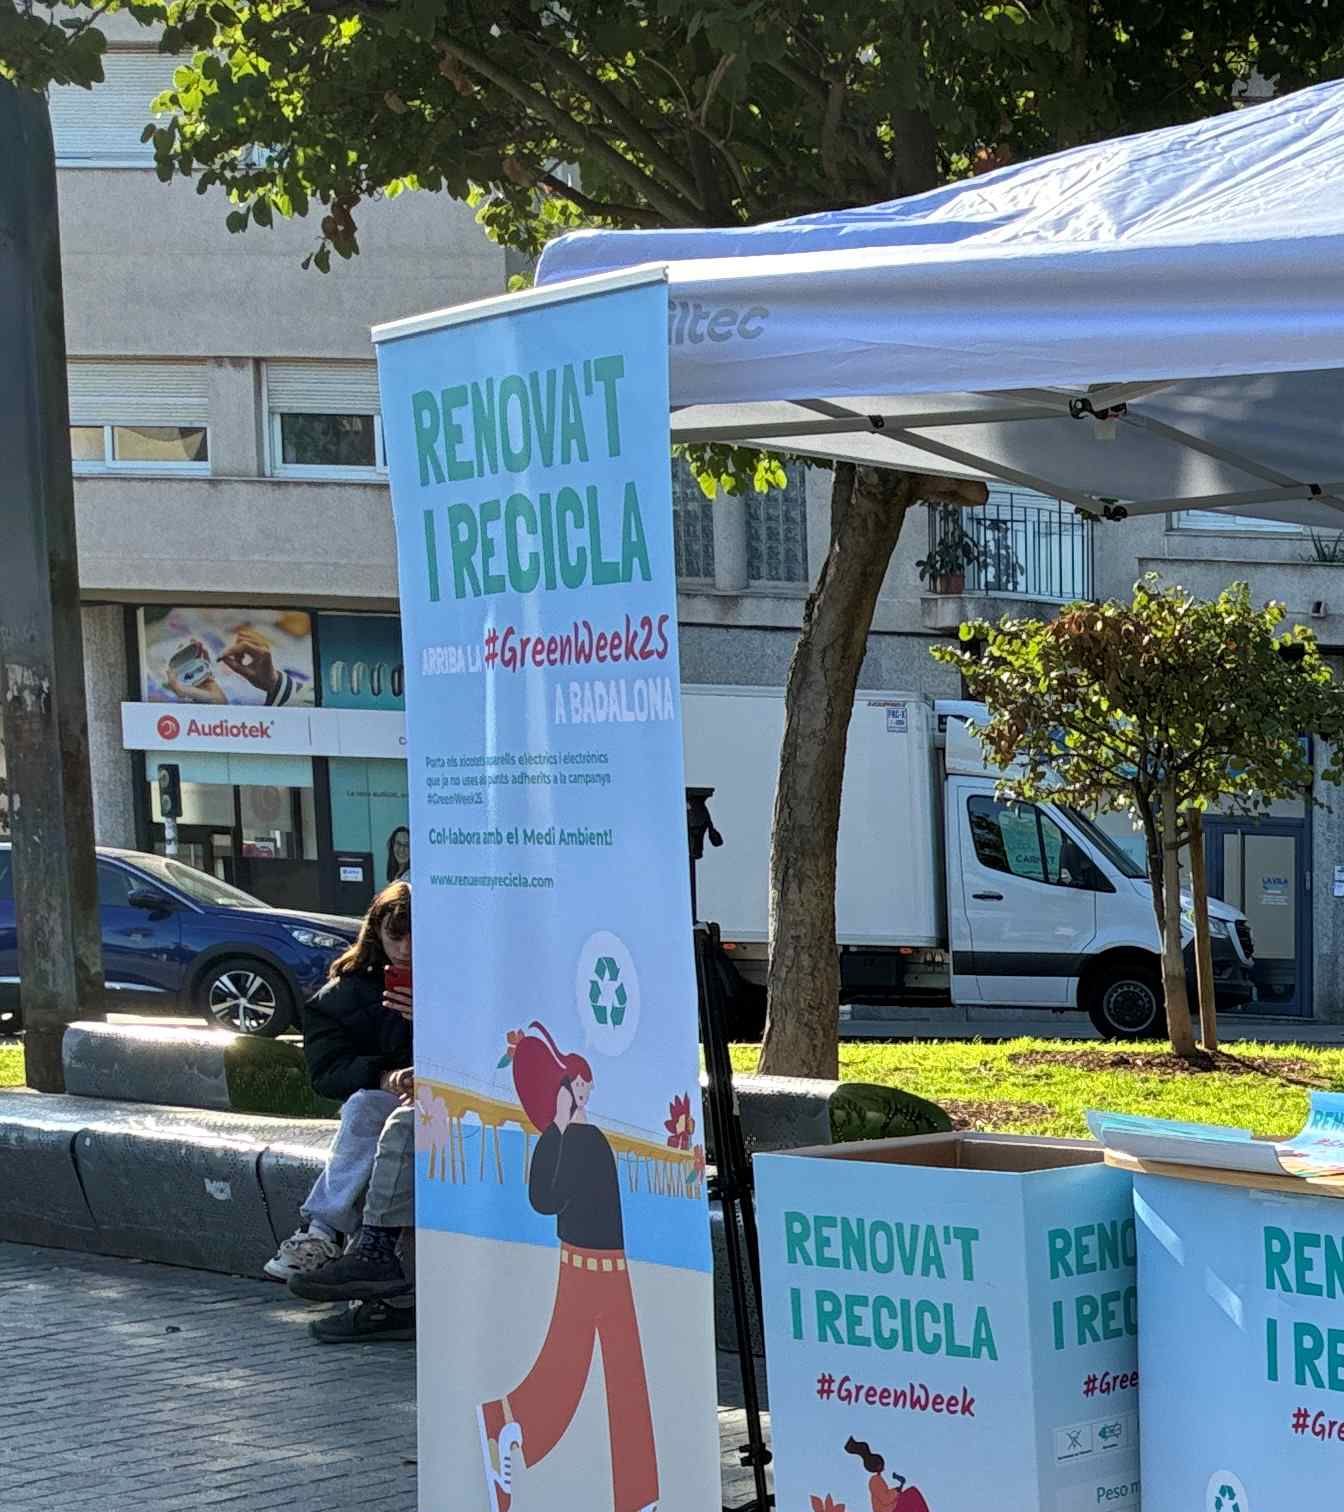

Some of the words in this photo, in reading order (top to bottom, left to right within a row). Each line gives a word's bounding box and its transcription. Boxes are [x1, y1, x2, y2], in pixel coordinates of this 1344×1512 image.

[411, 355, 624, 487] RENOVA'T
[424, 509, 440, 601] I
[448, 481, 651, 598] RECICLA
[422, 646, 464, 675] ARRIBA
[484, 613, 669, 672] #GreenWeek25
[555, 683, 566, 724] A
[570, 677, 674, 724] BADALONA
[186, 719, 271, 739] Audiotek
[483, 828, 503, 846] amb
[506, 827, 519, 845] el
[523, 827, 555, 846] Medi
[559, 828, 613, 847] Ambient!
[784, 1211, 980, 1281] RENOVA'T
[790, 1287, 802, 1340] I
[815, 1289, 998, 1361] RECICLA
[1052, 1300, 1065, 1350] I
[1266, 1318, 1278, 1382] I
[816, 1372, 976, 1418] #GreenWeek
[1097, 1484, 1128, 1503] Peso
